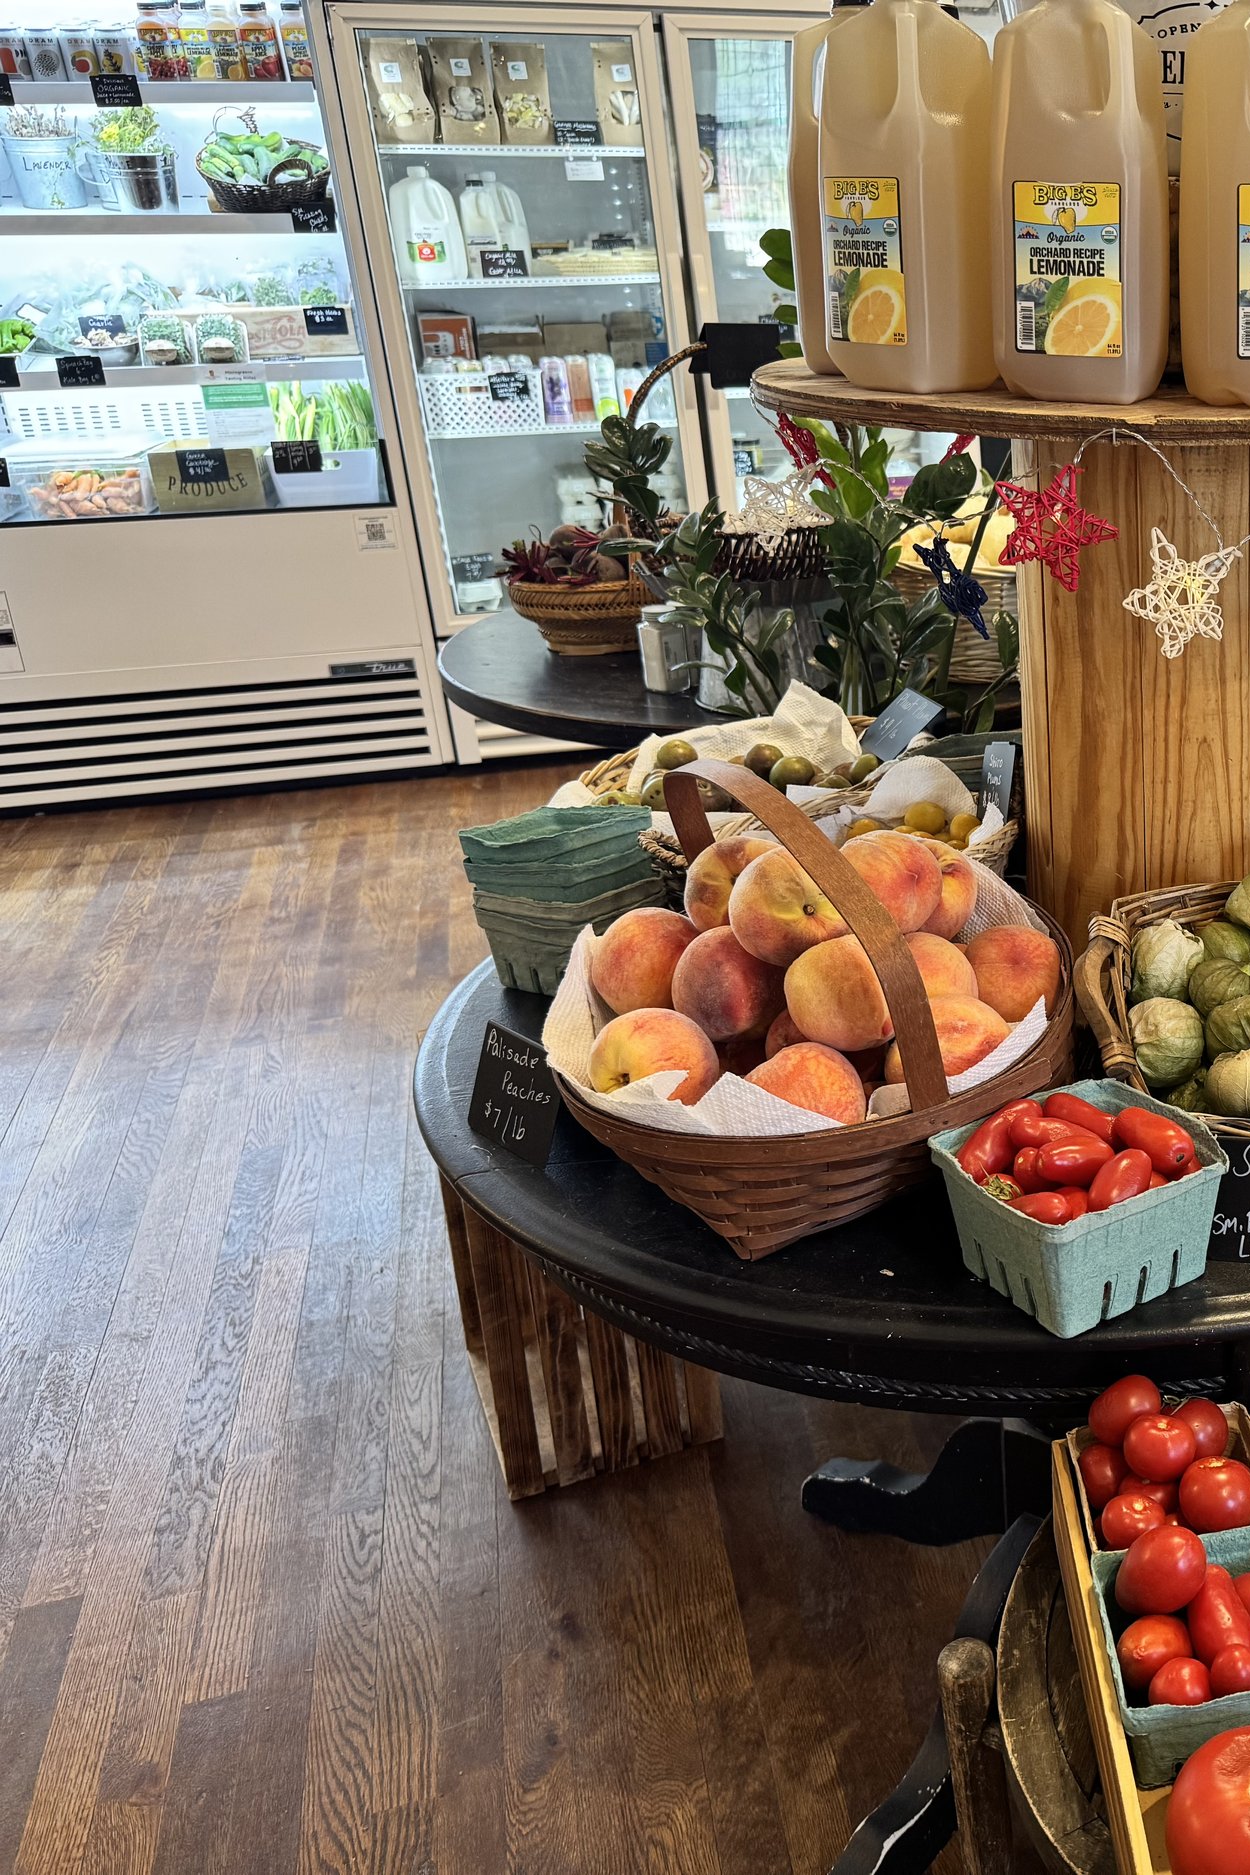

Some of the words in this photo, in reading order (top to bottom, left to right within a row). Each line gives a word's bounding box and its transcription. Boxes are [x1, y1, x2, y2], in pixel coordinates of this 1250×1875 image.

[834, 181, 858, 200] BIG
[859, 180, 880, 200] B'S
[1034, 185, 1067, 206] BIG
[1070, 185, 1098, 206] B'S
[843, 225, 872, 238] Organic
[1047, 232, 1086, 246] Organic
[833, 240, 861, 251] ORCHARD
[862, 240, 888, 252] RECIPE
[1030, 247, 1072, 259] ORCHARD
[1073, 248, 1106, 260] RECIPE
[834, 250, 888, 268] LEMONADE
[1030, 258, 1106, 278] LEMONADE
[168, 473, 248, 497] PRODUCE
[486, 1028, 540, 1070] Palisade
[502, 1070, 552, 1104] Peaches
